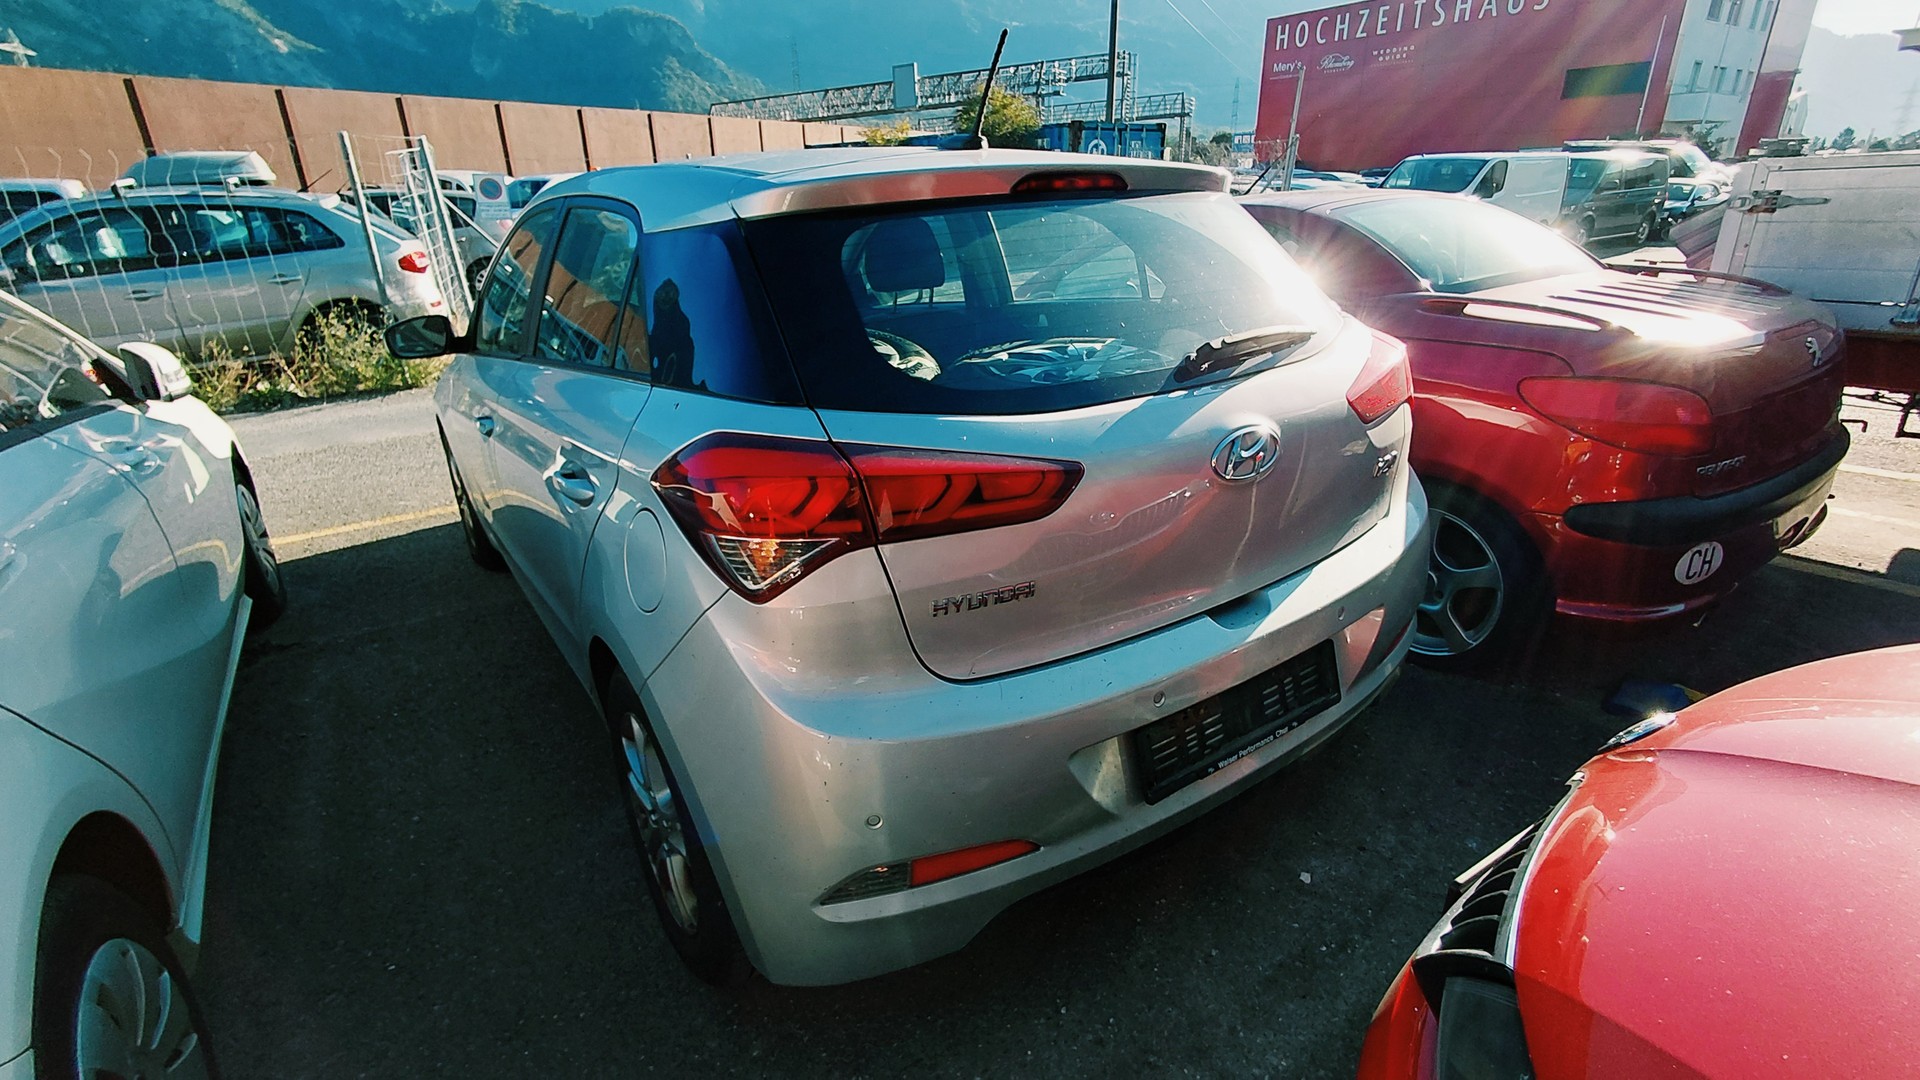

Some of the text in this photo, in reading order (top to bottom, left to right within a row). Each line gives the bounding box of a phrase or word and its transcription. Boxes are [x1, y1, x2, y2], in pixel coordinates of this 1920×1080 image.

[1372, 45, 1415, 56] WEDDING
[1378, 53, 1407, 62] GUIDE
[1273, 59, 1302, 73] Mery's
[1684, 546, 1716, 580] CH
[930, 580, 1036, 618] HYUNDAI
[1238, 734, 1274, 758] Performance
